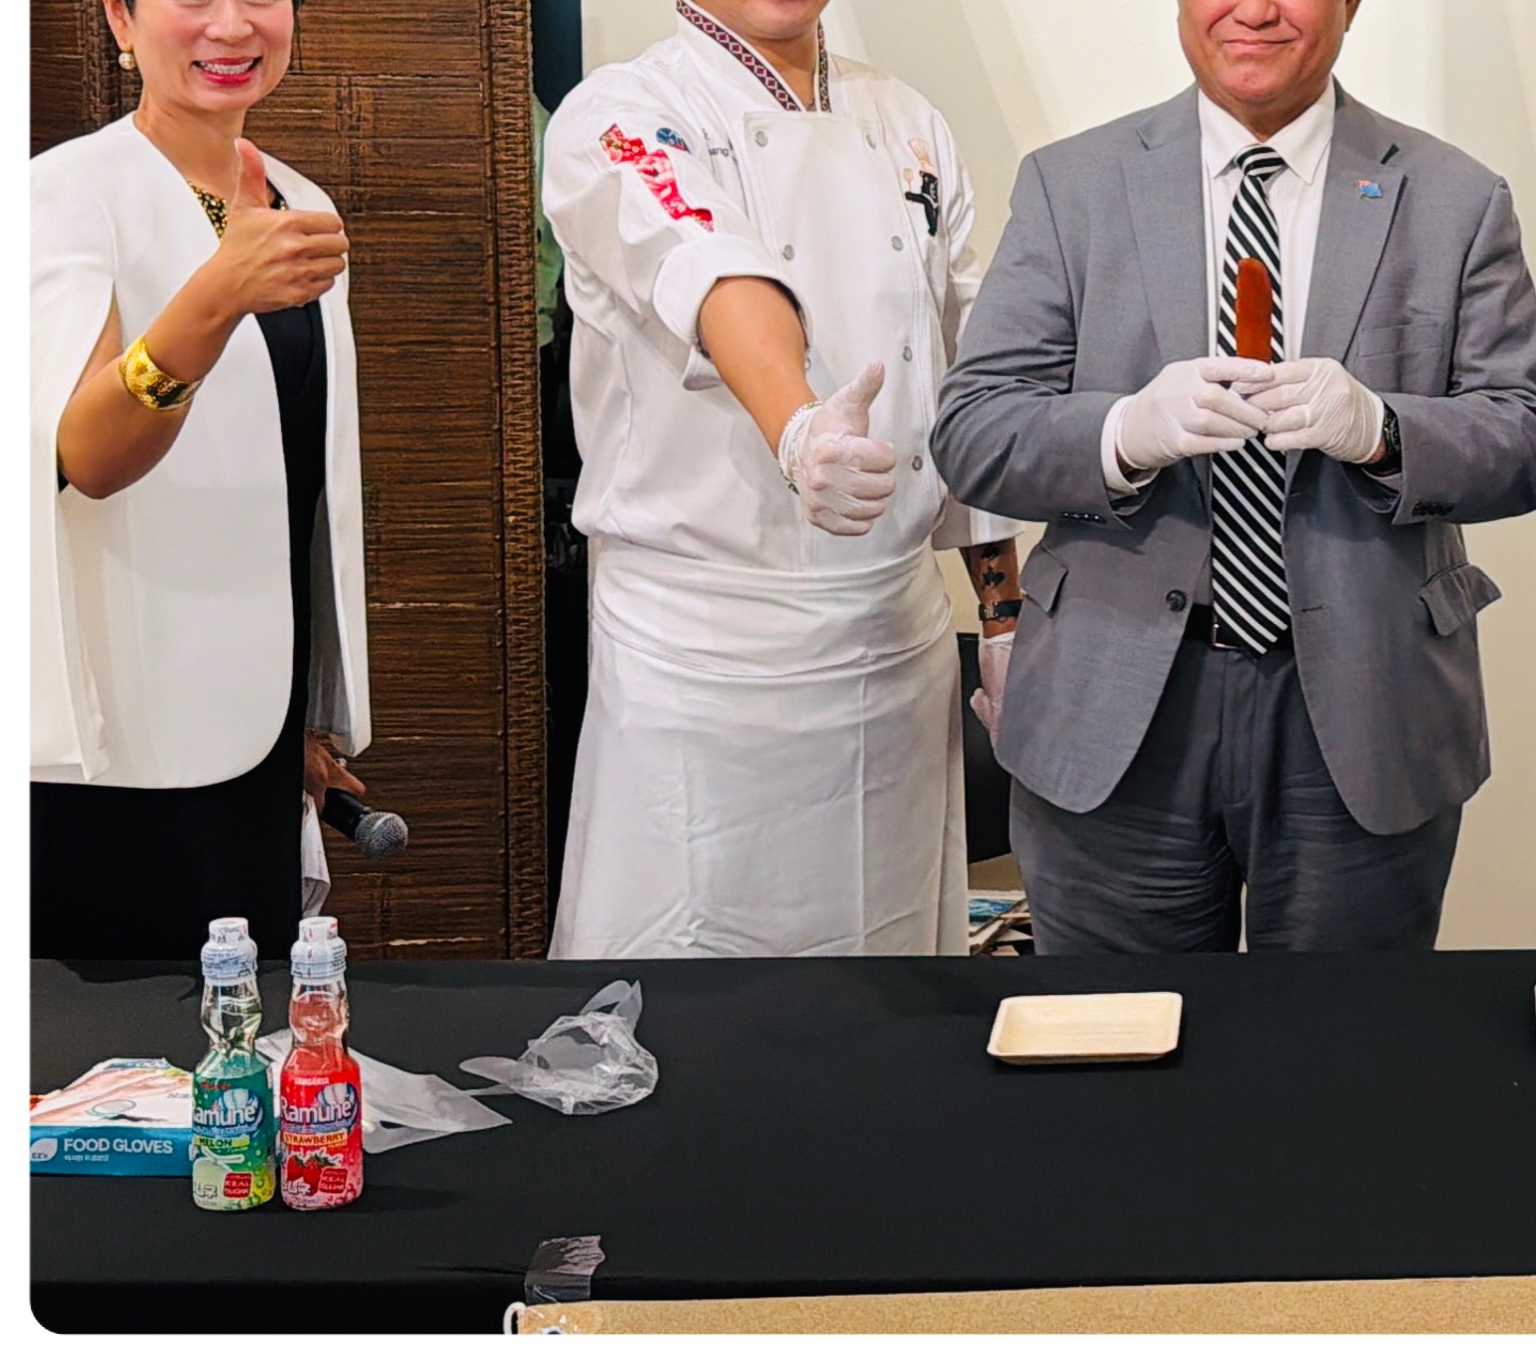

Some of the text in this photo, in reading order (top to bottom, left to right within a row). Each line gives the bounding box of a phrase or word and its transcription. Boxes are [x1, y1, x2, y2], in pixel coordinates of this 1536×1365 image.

[193, 1097, 257, 1127] amuné
[63, 1137, 174, 1155] FOOD GLOVES
[200, 1136, 233, 1148] MELON
[283, 1131, 346, 1145] STRAWBERRY
